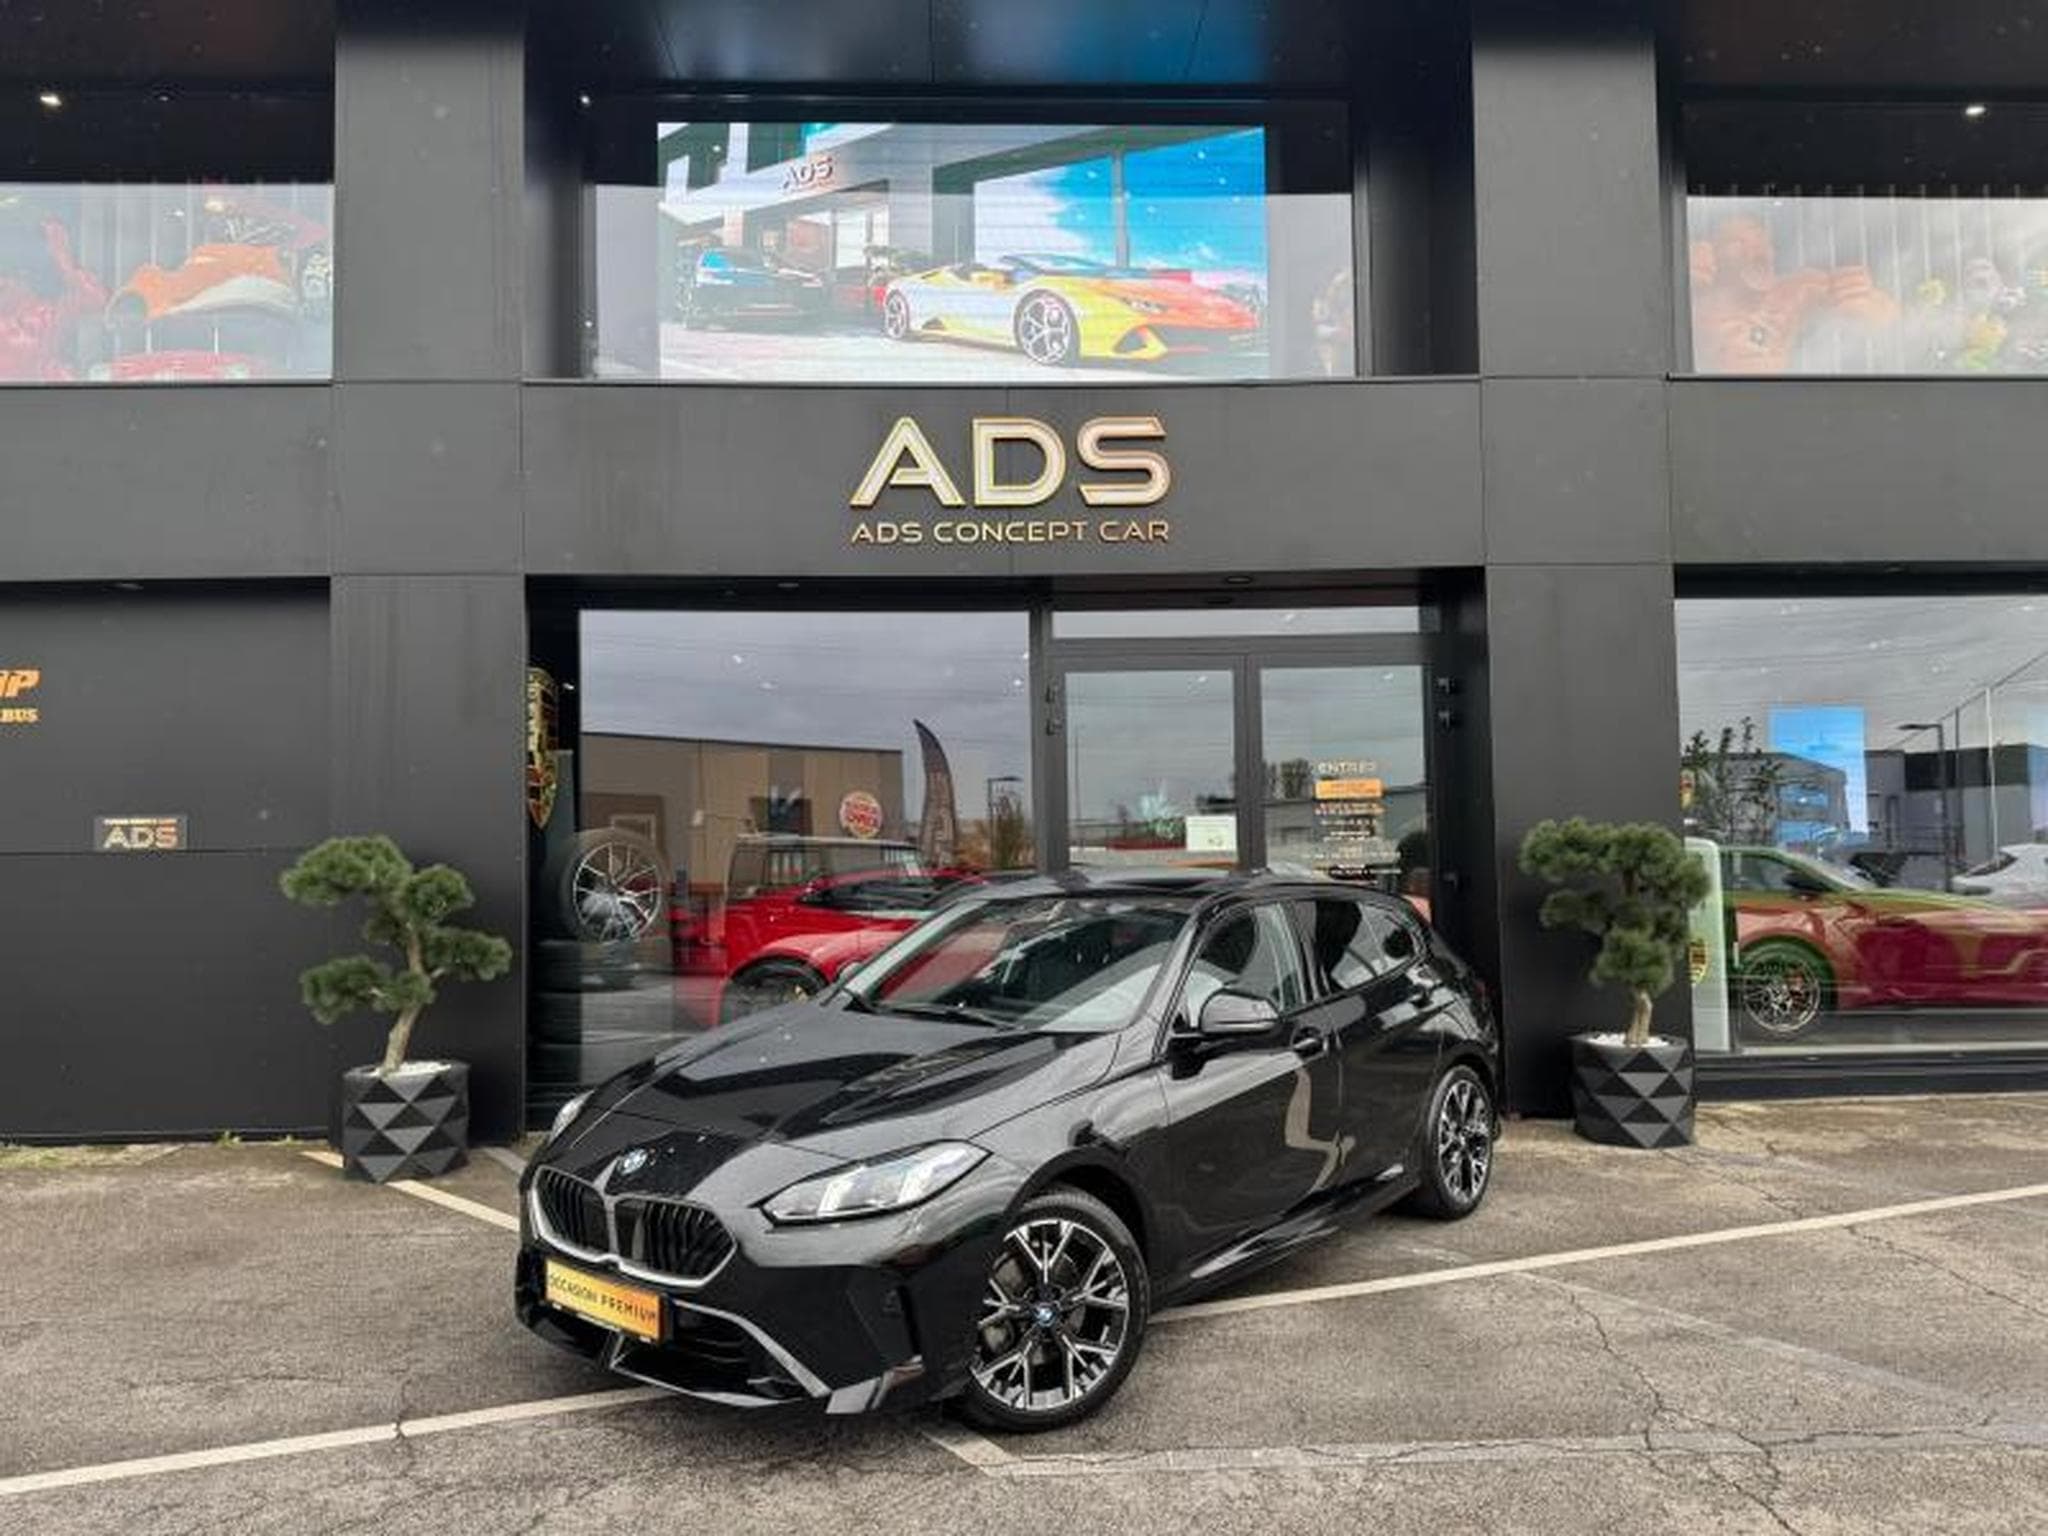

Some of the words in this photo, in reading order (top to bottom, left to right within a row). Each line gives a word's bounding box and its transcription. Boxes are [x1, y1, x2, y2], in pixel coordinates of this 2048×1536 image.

[850, 416, 1171, 507] ADS
[851, 522, 922, 543] ADS
[933, 521, 1086, 542] CONCEPT
[1100, 520, 1169, 542] CAR
[103, 826, 177, 848] ADS
[601, 1293, 656, 1322] PREMIUM
